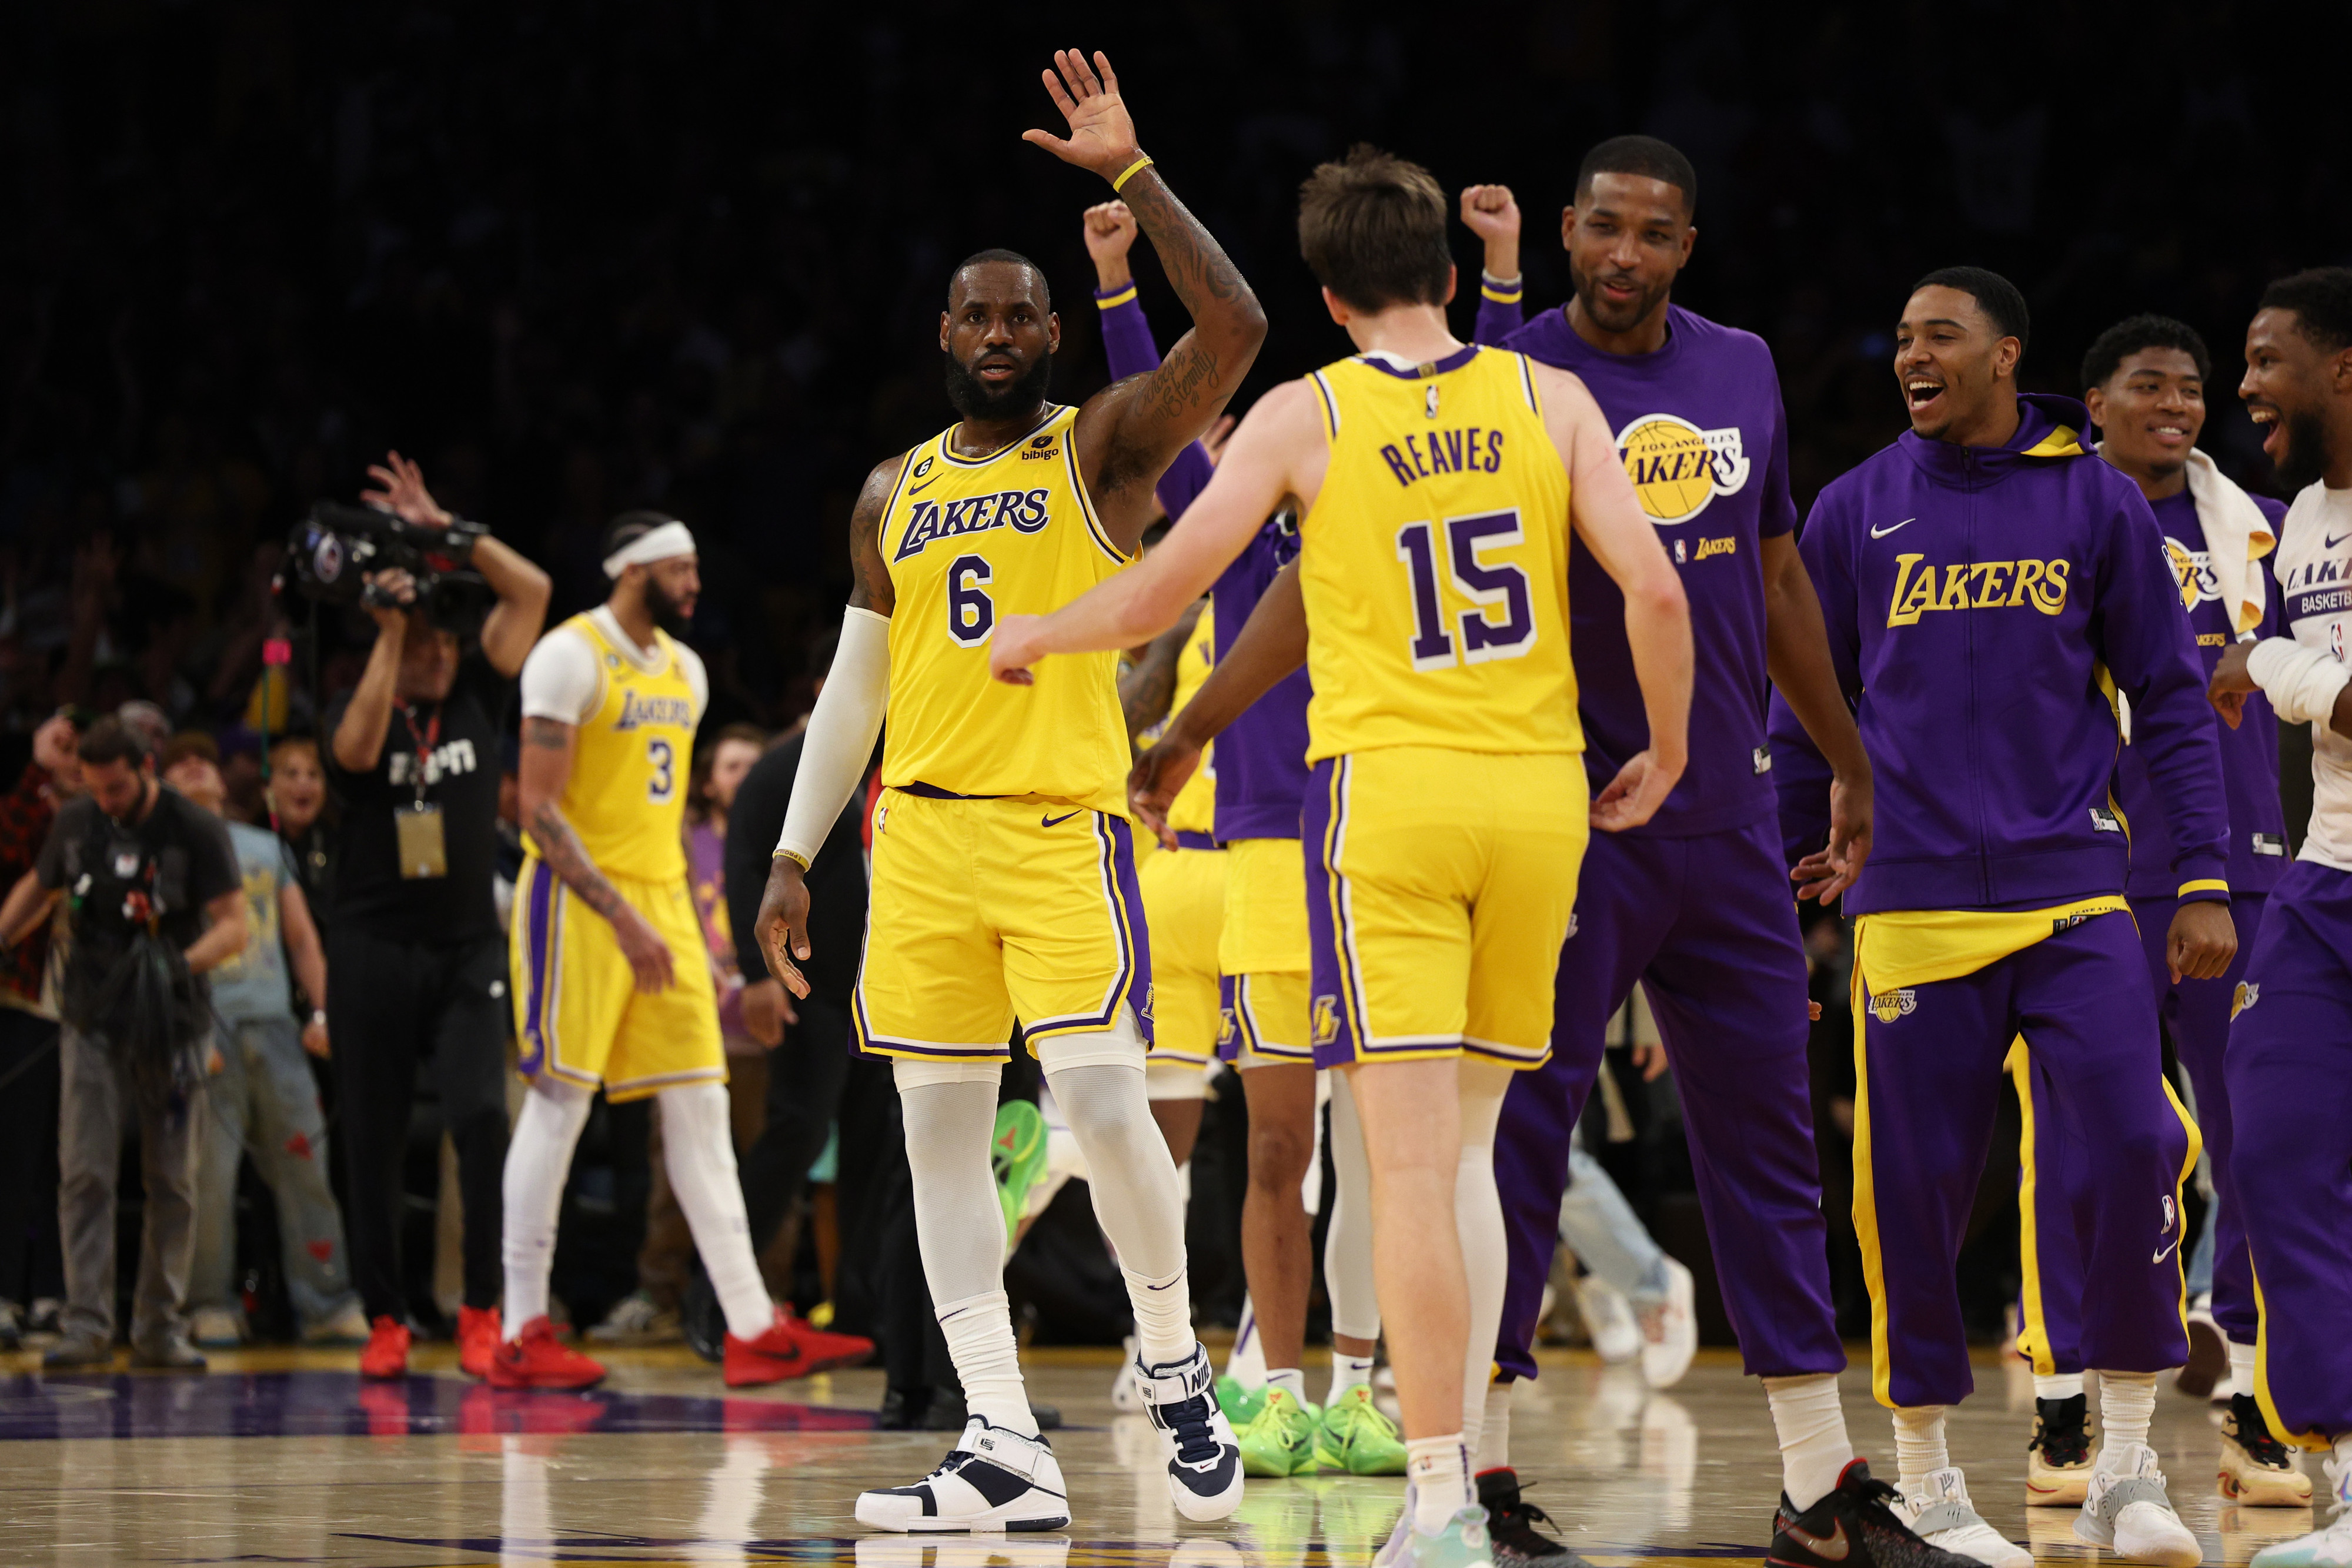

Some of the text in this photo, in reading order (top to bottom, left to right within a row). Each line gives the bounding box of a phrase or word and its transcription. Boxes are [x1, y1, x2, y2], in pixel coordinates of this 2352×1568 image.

[1021, 449, 1059, 460] bibigo
[1380, 428, 1504, 487] REAVES
[1641, 433, 1735, 452] LOS ANGELES
[917, 459, 931, 476] 6
[893, 488, 1051, 566] LAKERS
[1693, 536, 1736, 560] LAKERS
[947, 553, 995, 649] 6
[1394, 506, 1538, 673] 15
[1887, 553, 2070, 628] LAKERS
[2301, 589, 2352, 614] BASKETB
[647, 737, 675, 804] 3
[1870, 995, 1916, 1012] LAKERS
